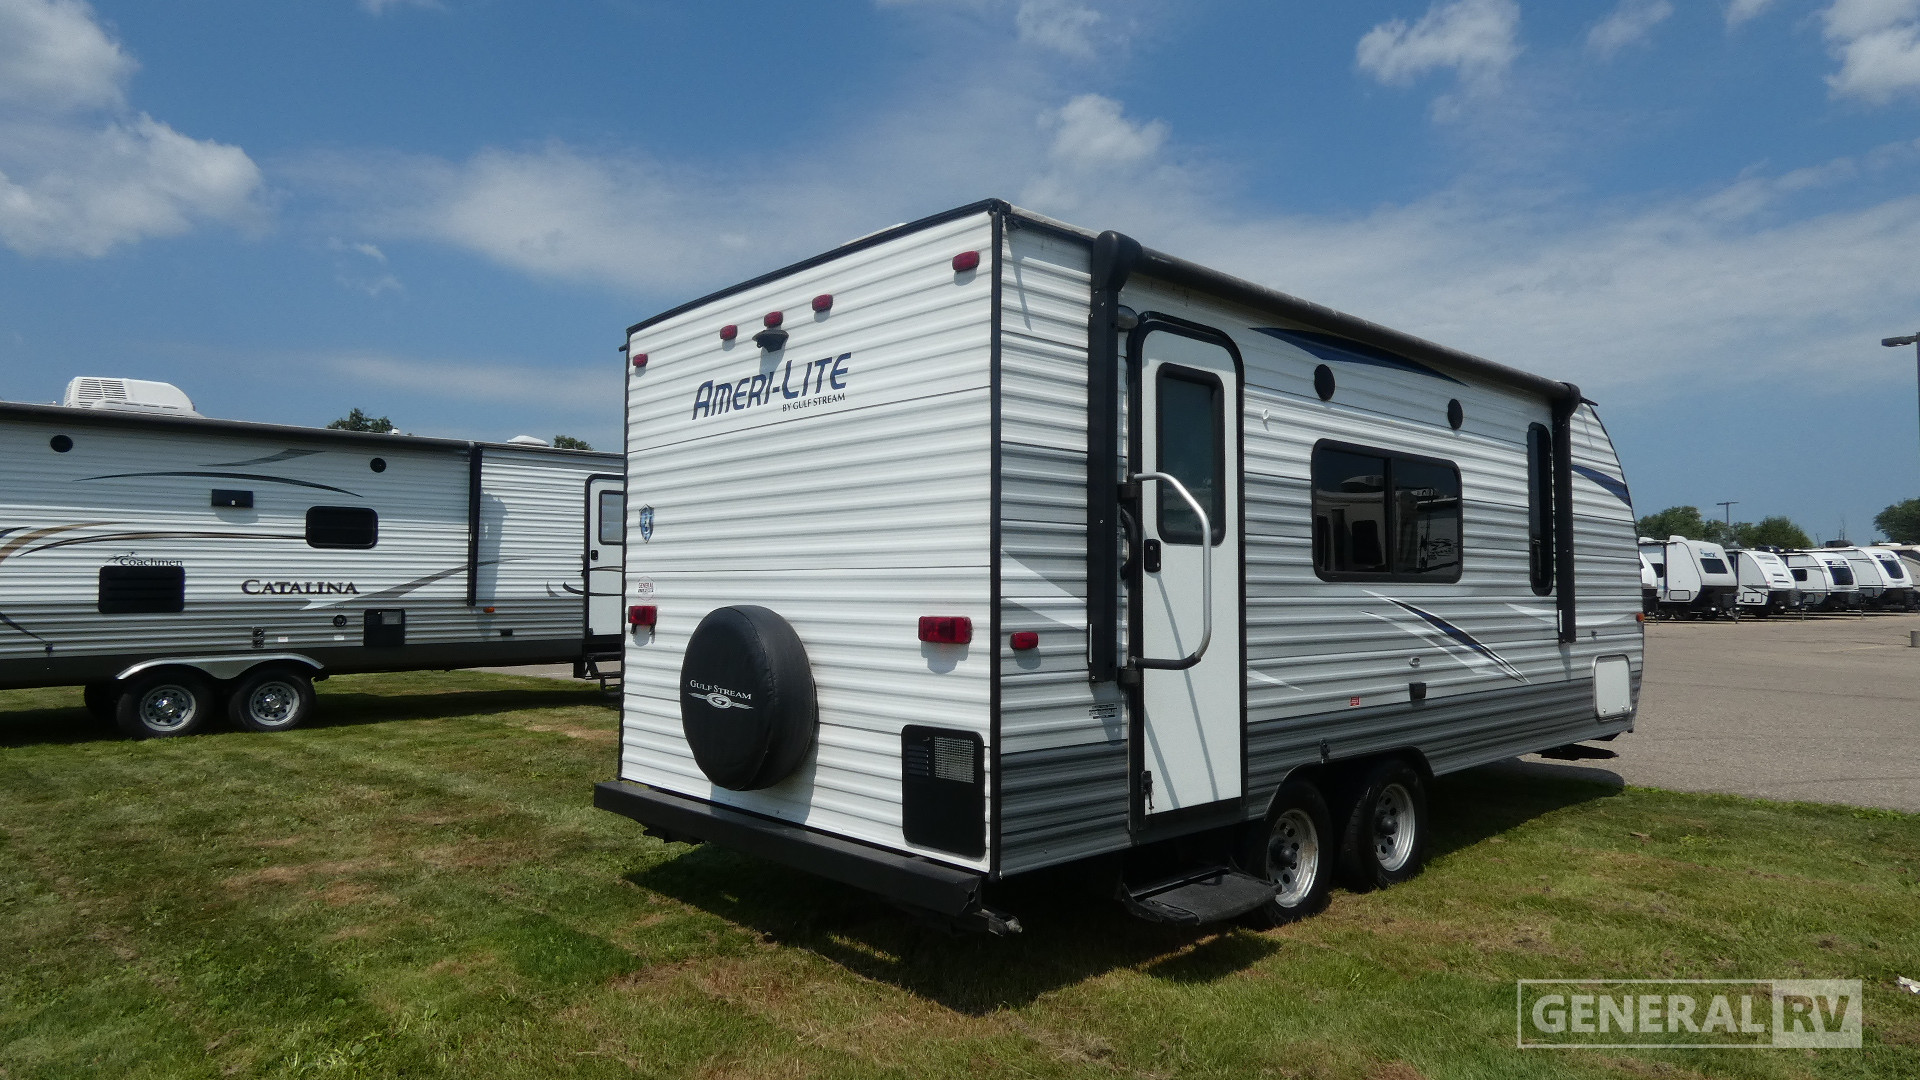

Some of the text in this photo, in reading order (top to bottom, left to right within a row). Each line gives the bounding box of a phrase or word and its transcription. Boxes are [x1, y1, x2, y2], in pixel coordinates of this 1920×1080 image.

[692, 352, 852, 420] AMERI-LITE
[782, 393, 846, 412] BY GULF STREAM
[120, 557, 183, 567] Coachmen
[241, 579, 360, 595] CATALINA
[690, 679, 752, 700] GULF STREAM
